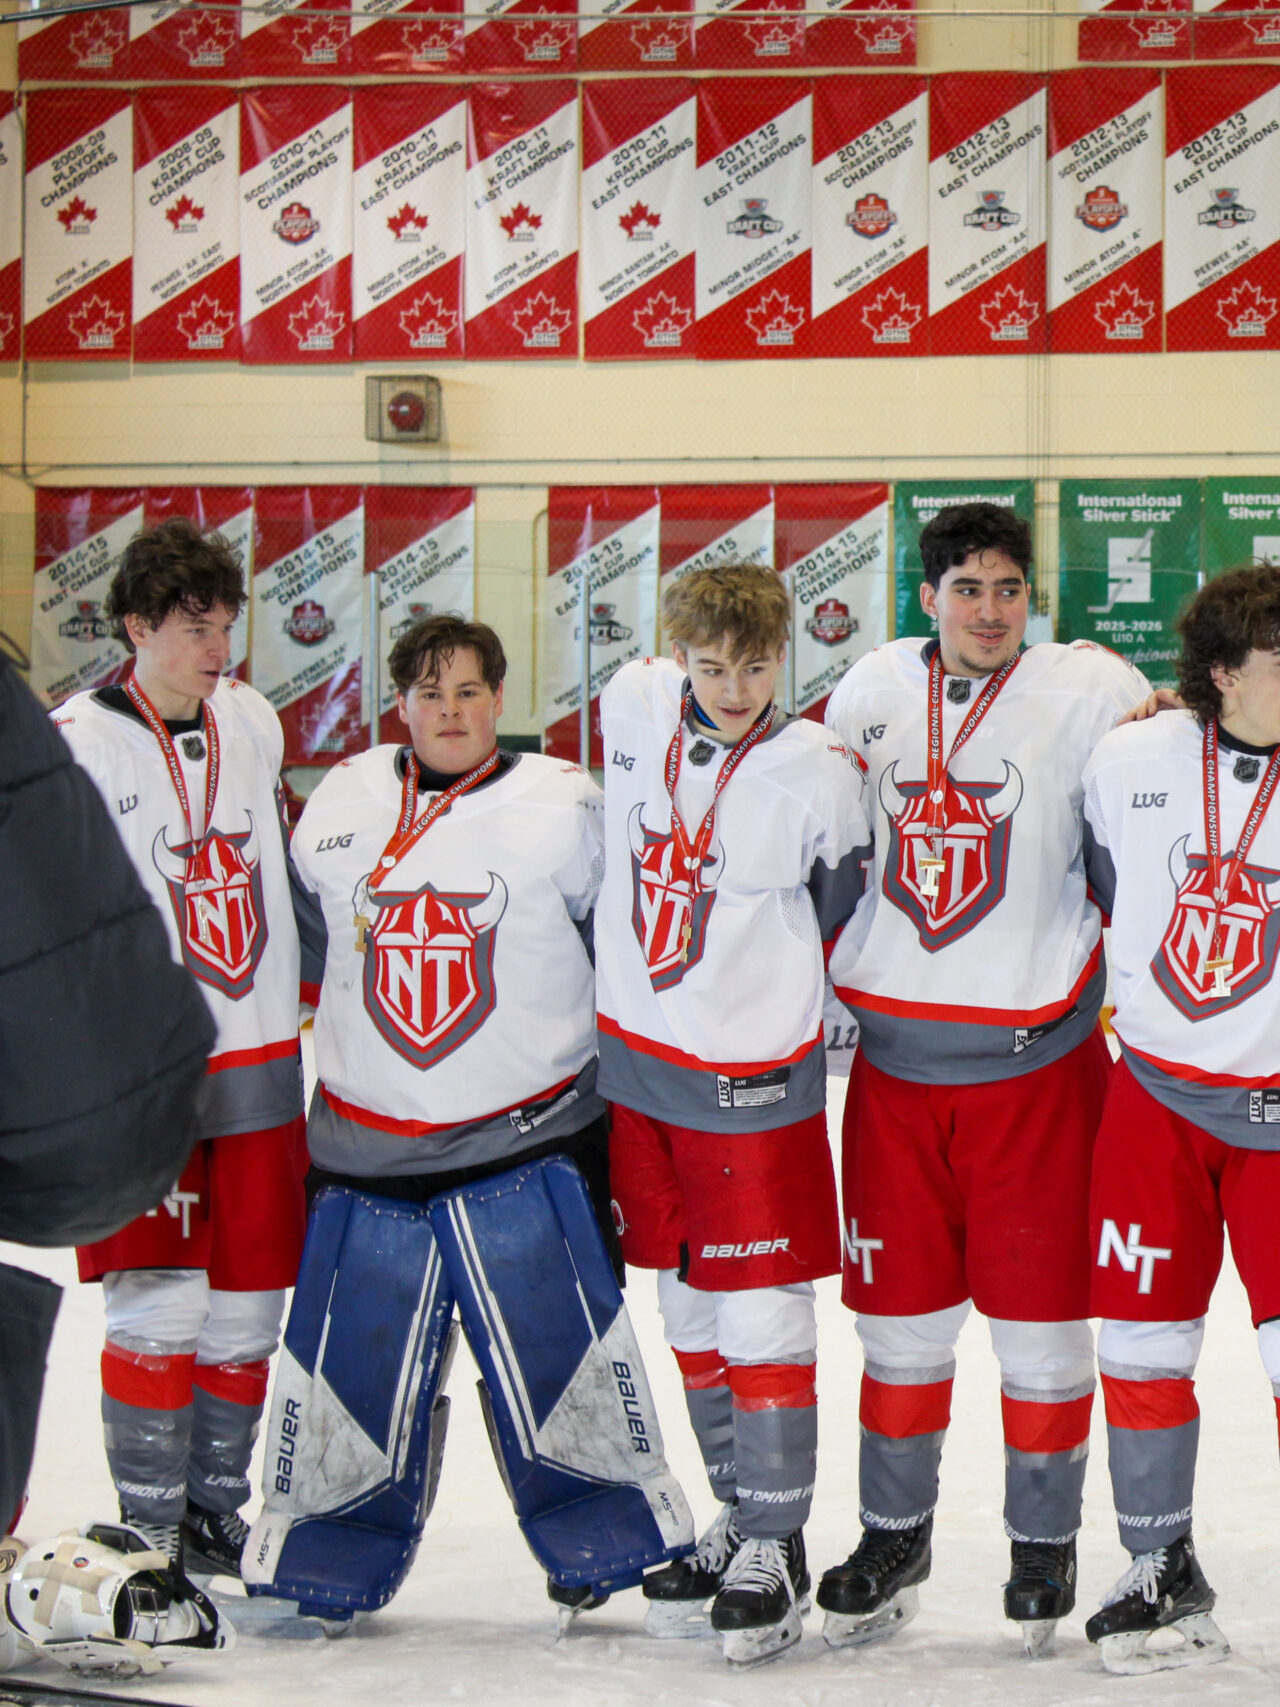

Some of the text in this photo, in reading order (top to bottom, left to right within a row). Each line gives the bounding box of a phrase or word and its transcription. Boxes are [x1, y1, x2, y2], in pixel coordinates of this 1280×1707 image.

[51, 130, 106, 171] 2008-09
[158, 127, 213, 170] 2008-09
[270, 129, 324, 170] 2010-11
[381, 128, 437, 168] 2010-11
[494, 127, 549, 168] 2010-11
[611, 125, 667, 167] 2010-11
[715, 122, 779, 171] 2011-12
[726, 137, 780, 177] KRAFT CUP
[824, 118, 918, 186] SCOTIABANK PLAYOFF
[837, 120, 894, 163] 2012-13
[946, 117, 1010, 165] 2012-13
[957, 132, 1012, 172] KRAFT CUP
[1058, 111, 1153, 179] SCOTIABANK PLAYOFF
[1071, 114, 1129, 158] 2012-13
[1076, 129, 1149, 183] CHAMPIONS
[1174, 120, 1280, 194] EAST CHAMPIONS
[1182, 112, 1247, 160] 2012-13
[1193, 127, 1249, 167] KRAFT CUP
[41, 152, 118, 208] CHAMPIONS
[52, 144, 106, 185] PLAYOFF
[148, 150, 225, 207] CHAMPIONS
[151, 137, 221, 190] KRAFT CUP
[243, 127, 350, 203] SCOTIABANK PLAYOFF
[257, 152, 339, 210] CHAMPIONS
[360, 141, 463, 211] EAST CHAMPIONS
[375, 142, 439, 188] KRAFT CUP
[487, 140, 551, 187] KRAFT CUP
[505, 139, 575, 190] CHAMPIONS
[591, 138, 694, 210] EAST CHAMPIONS
[606, 138, 670, 186] KRAFT CUP
[703, 134, 807, 207] EAST CHAMPIONS
[842, 136, 914, 189] CHAMPIONS
[938, 124, 1043, 199] EAST CHAMPIONS
[708, 246, 779, 295] MINOR MIDGET
[834, 250, 888, 289] MINOR ATOM
[945, 244, 1007, 288] MINOR ATOM
[960, 246, 1029, 293] NORTH TORONTO
[1064, 240, 1127, 284] MINOR ATOM
[1073, 246, 1142, 293] NORTH TORONTO
[1194, 252, 1231, 278] PEEWEE
[1077, 493, 1182, 509] International
[1082, 509, 1173, 523] Silver Stick
[1228, 507, 1275, 520] Silver
[48, 536, 108, 581] 2014-15
[274, 533, 335, 580] 2014-15
[378, 537, 439, 584] 2014-15
[605, 553, 625, 569] CUP
[796, 530, 858, 578] 2014-15
[844, 528, 884, 559] PLAYOFF
[58, 551, 109, 589] KRAFT CUP
[277, 548, 357, 606] CHAMPIONS
[389, 552, 441, 590] KRAFT CUP
[401, 545, 469, 595] CHAMPIONS
[800, 546, 881, 605] CHAMPIONS
[40, 589, 68, 613] EAST
[1112, 633, 1133, 643] U10
[273, 683, 305, 706] NORTH
[291, 659, 327, 684] PEEWEE
[802, 670, 837, 692] MIDGET
[127, 681, 188, 811] REGIONAL CHAMPIONSHIPS
[720, 704, 778, 776] CHAMPIONSHIPS
[931, 707, 941, 760] REGIONAL
[206, 726, 218, 812] CHAMPIONSHIPS
[411, 793, 451, 837] REGIONAL
[1132, 792, 1168, 808] LUG
[1206, 758, 1218, 856] CHAMPIONSHIPS
[315, 833, 356, 853] LUG
[1237, 805, 1262, 860] REGIONAL
[191, 888, 246, 967] NT
[1176, 909, 1255, 987] NT
[384, 949, 462, 1033] NT
[719, 1080, 730, 1103] LUG
[1251, 1095, 1262, 1119] LUG
[701, 1237, 790, 1259] BAUER
[1097, 1218, 1172, 1294] NT
[613, 1361, 649, 1454] BAUER
[275, 1398, 301, 1495] BAUER
[753, 1487, 801, 1503] OMNIA
[863, 1511, 918, 1530] OMNIA
